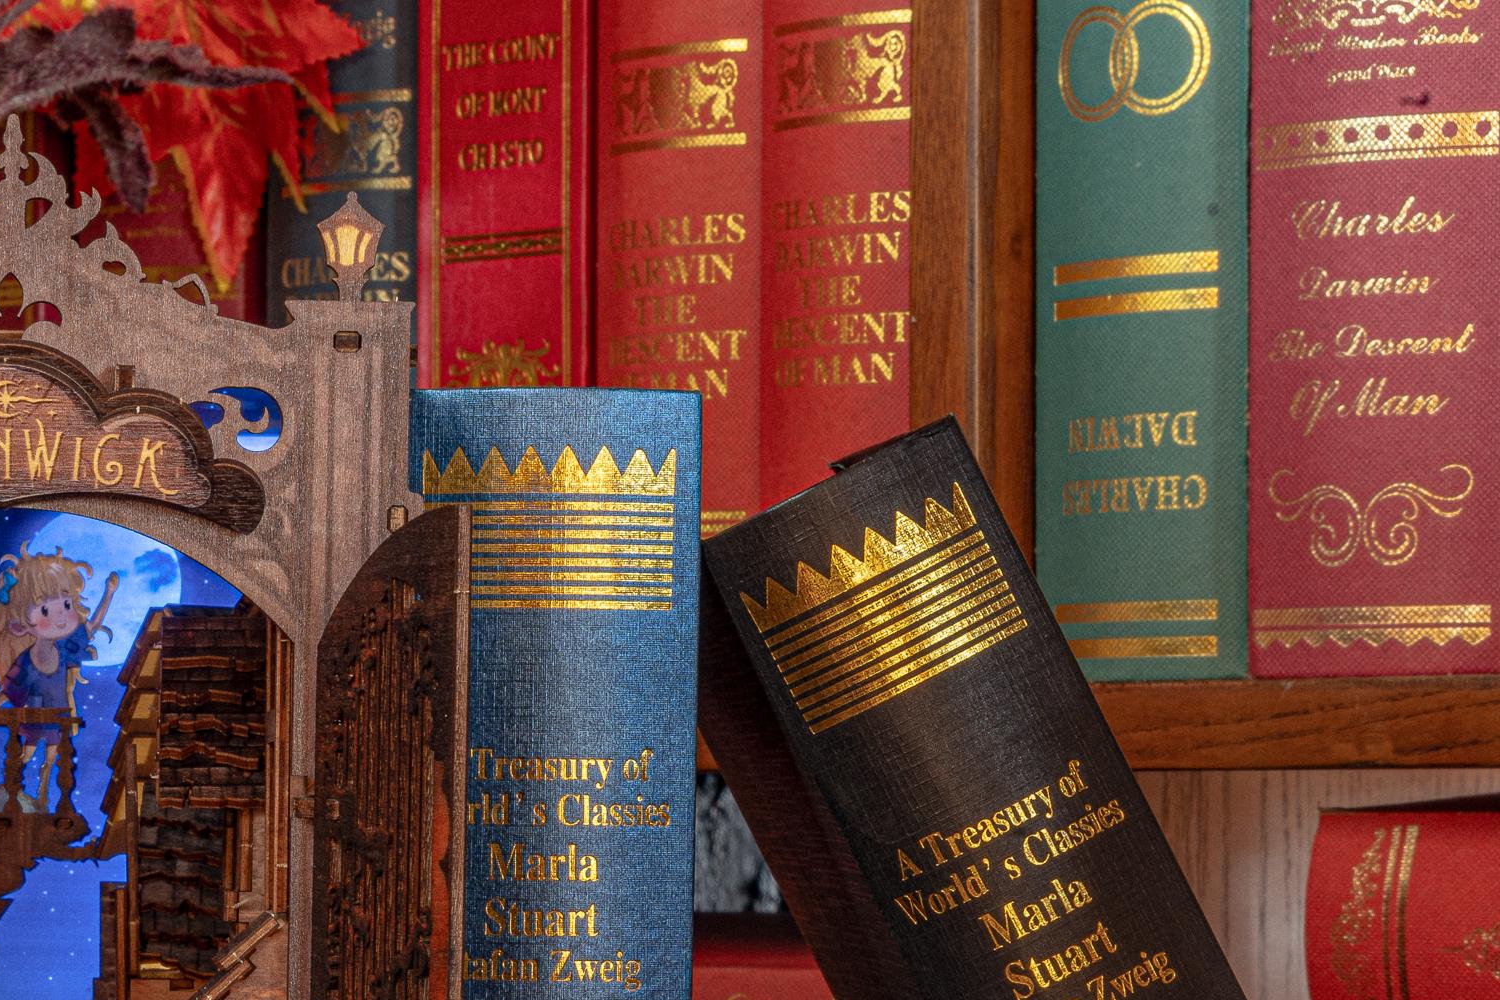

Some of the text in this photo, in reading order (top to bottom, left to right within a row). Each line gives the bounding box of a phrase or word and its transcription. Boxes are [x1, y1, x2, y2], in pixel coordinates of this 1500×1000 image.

[442, 32, 561, 72] THE COUNT
[455, 92, 486, 120] OF
[770, 190, 911, 231] CHARLES
[1291, 195, 1455, 240] Charles
[609, 212, 746, 252] CHARLES
[774, 231, 901, 273] DARWIN
[801, 275, 862, 309] THE
[1298, 266, 1440, 301] Darwin
[633, 294, 698, 327] THE
[1334, 323, 1476, 357] Descent
[813, 352, 896, 387] MAN
[1337, 377, 1450, 418] Man
[1062, 474, 1209, 518] CHARLES
[470, 747, 654, 790] Treasury of
[896, 759, 1089, 882] A Treasury of
[487, 842, 599, 882] Marla
[484, 896, 599, 937] Stuart
[978, 878, 1093, 952] Marla
[463, 949, 642, 992] tafan Zweig
[1004, 920, 1118, 1000] Stuart
